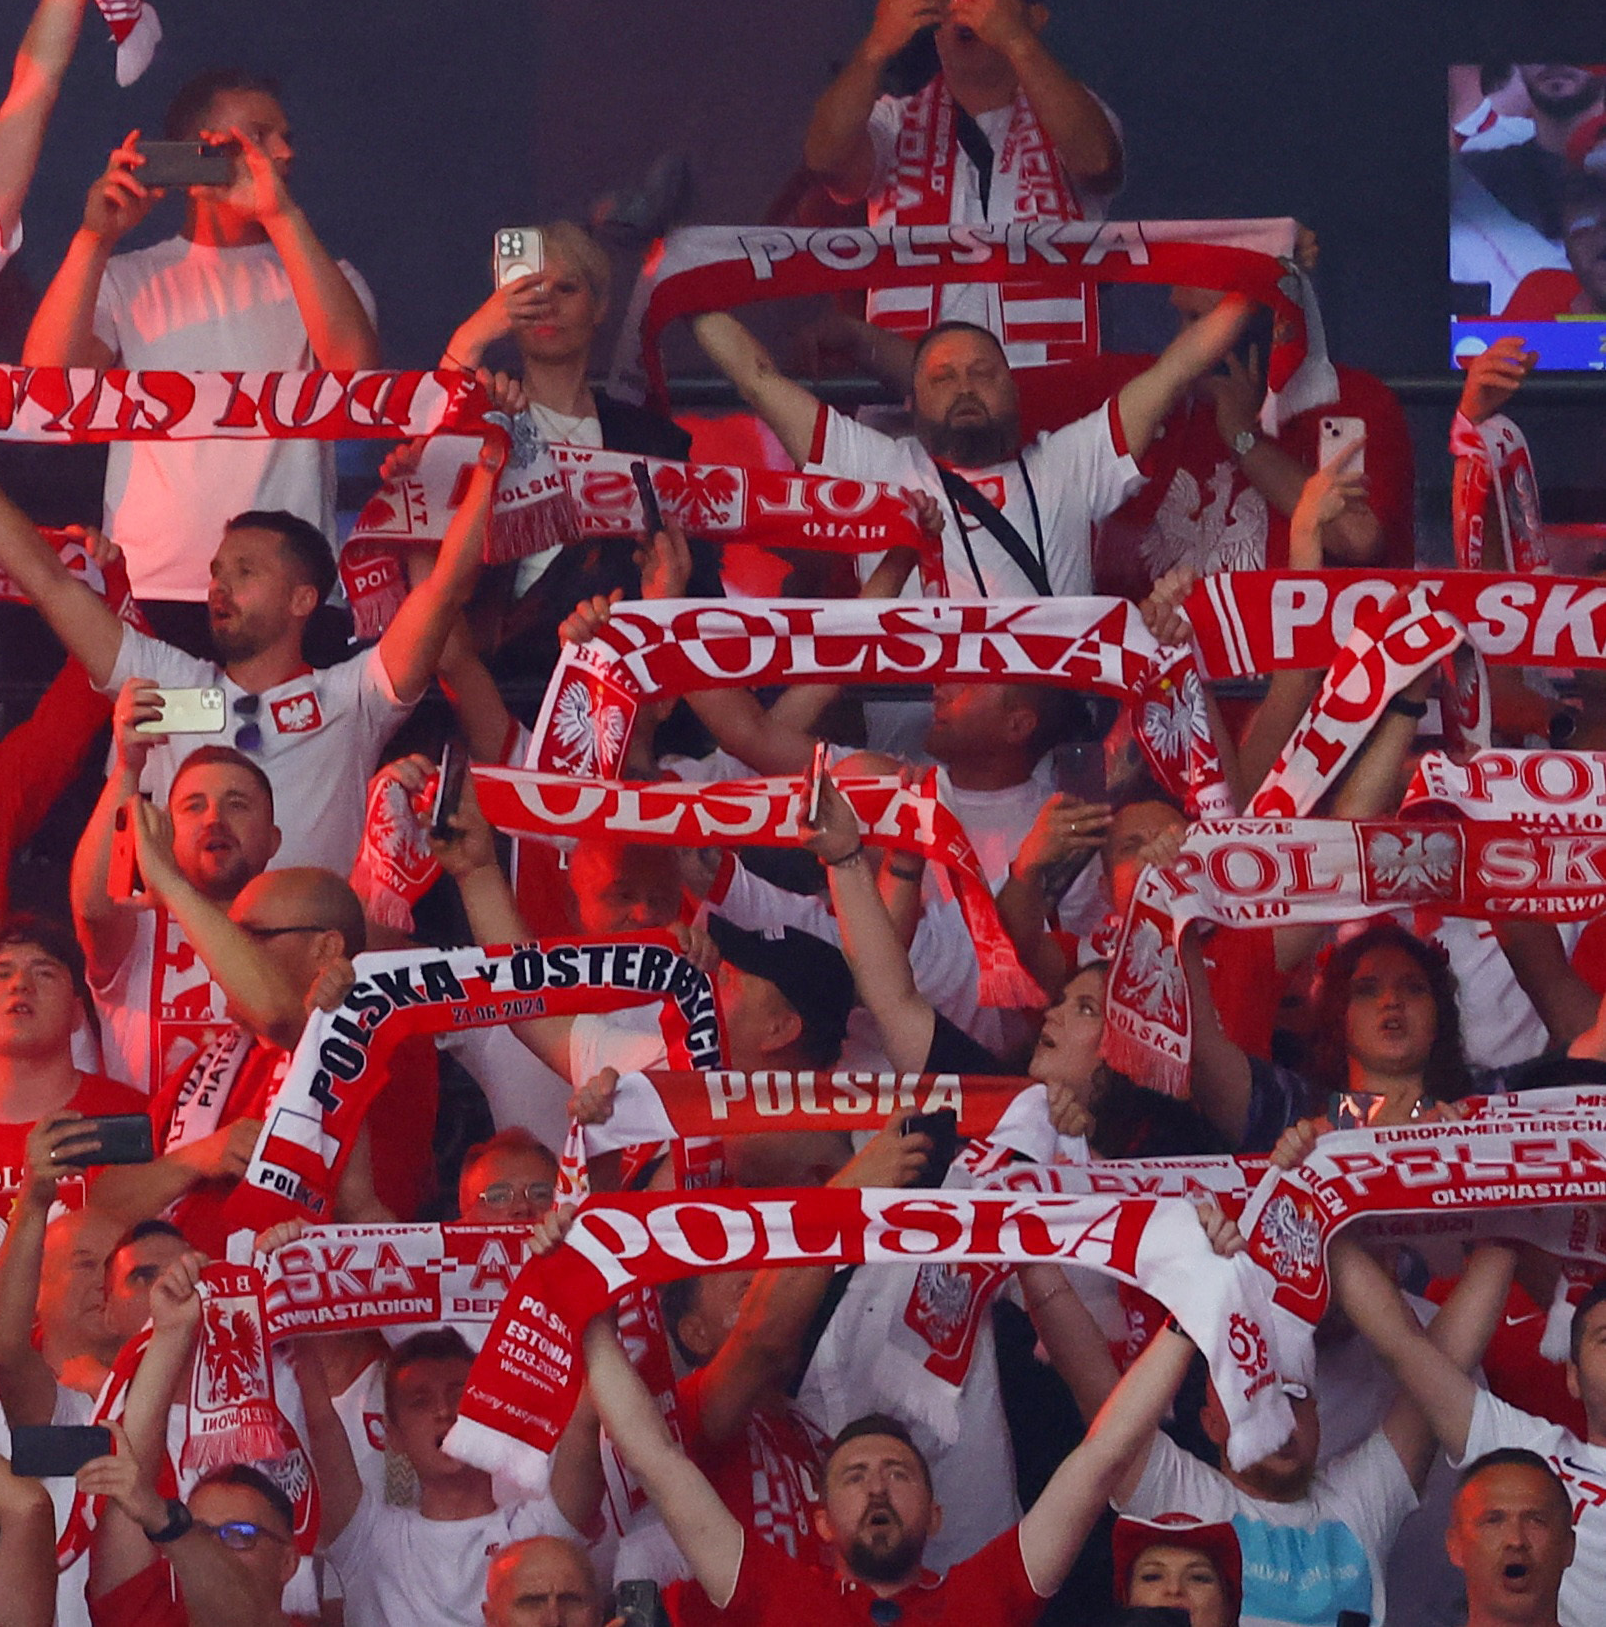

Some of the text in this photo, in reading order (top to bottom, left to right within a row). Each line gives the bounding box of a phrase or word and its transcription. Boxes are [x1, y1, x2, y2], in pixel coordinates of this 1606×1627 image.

[739, 222, 1153, 282] POLSKA
[607, 602, 1132, 692] POLSKA
[306, 952, 469, 1118] POLSKA
[573, 1186, 1157, 1304] POLSKA
[267, 1296, 434, 1334] LYMPIASTADION
